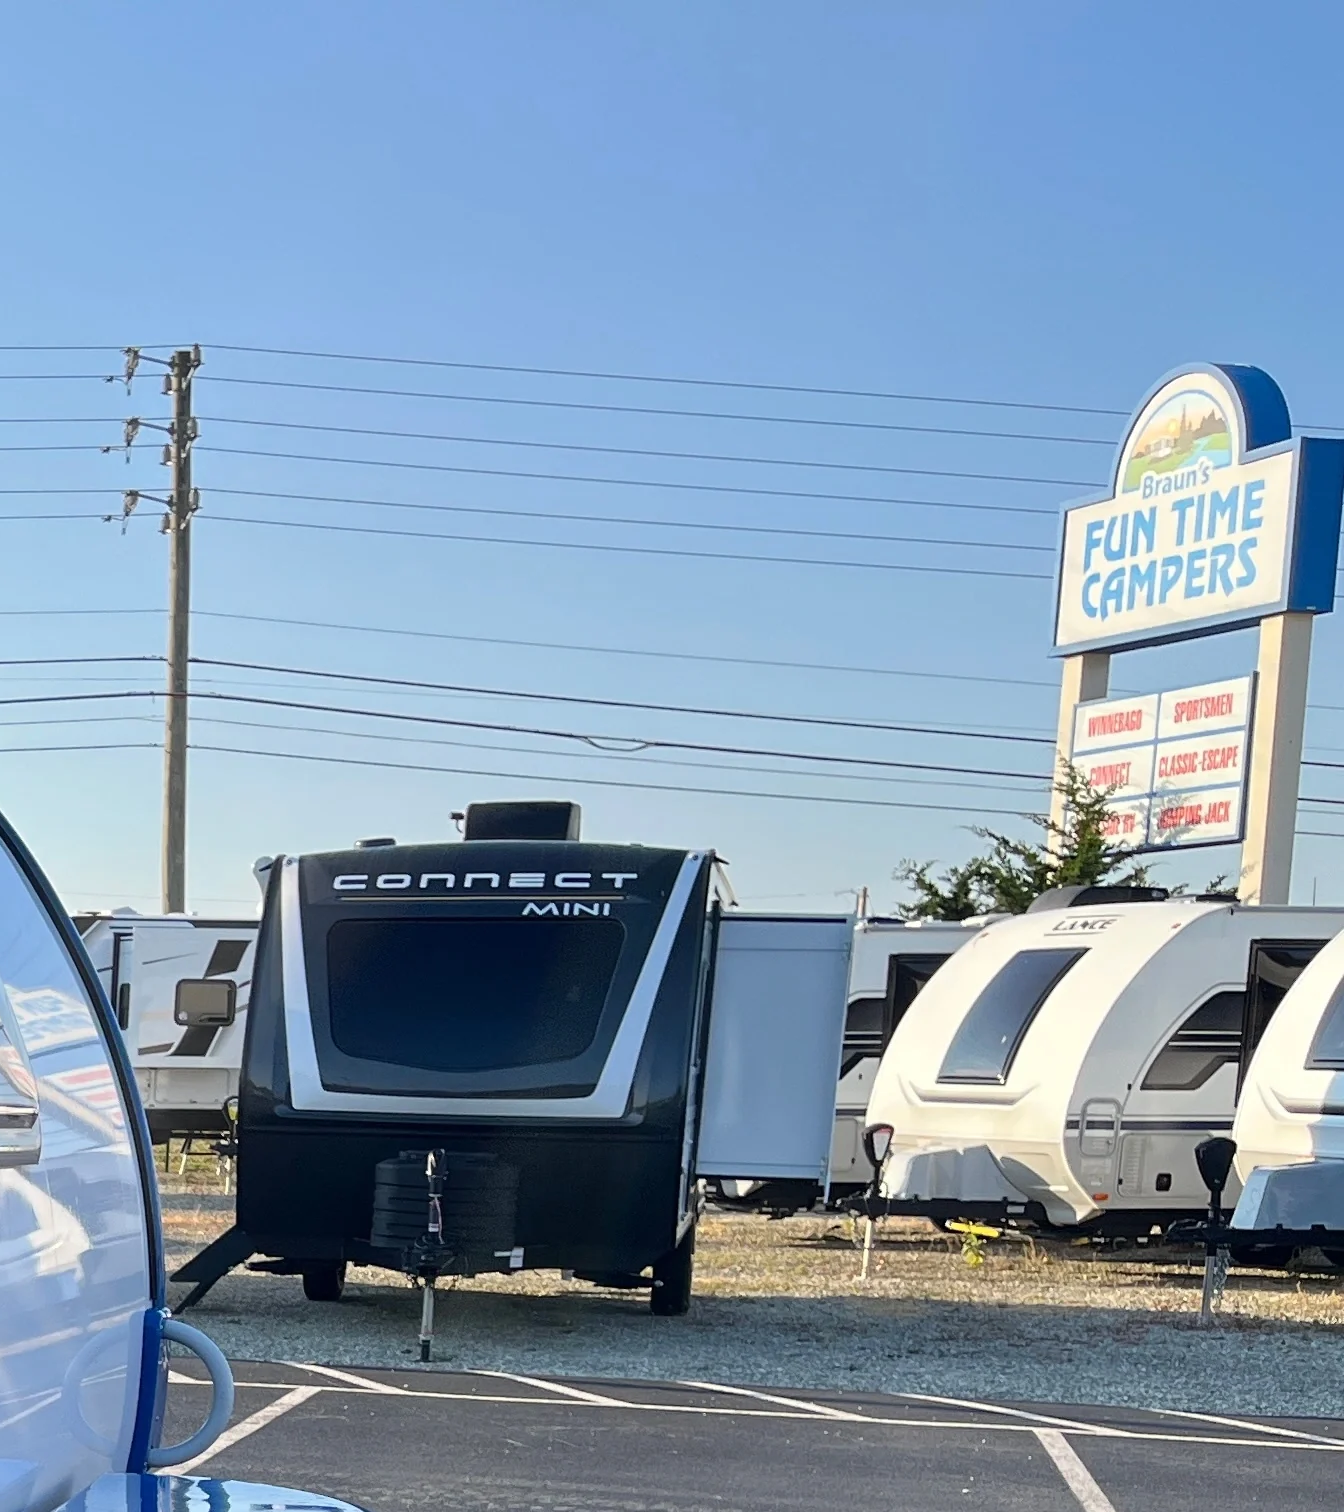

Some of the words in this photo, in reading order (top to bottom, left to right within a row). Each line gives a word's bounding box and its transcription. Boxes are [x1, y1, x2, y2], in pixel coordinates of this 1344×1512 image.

[1142, 463, 1210, 500] Braun's
[1083, 506, 1157, 574] FUN
[1171, 479, 1265, 546] TIME
[1081, 537, 1258, 622] CAMPERS
[1088, 709, 1143, 737] WINNEBAGO
[1174, 693, 1234, 723] SPORTSMEN
[1158, 745, 1239, 778] CLASSIC-ESCAPE
[1204, 800, 1231, 824] JACK
[332, 872, 638, 891] CONNECT
[522, 902, 611, 917] MINI
